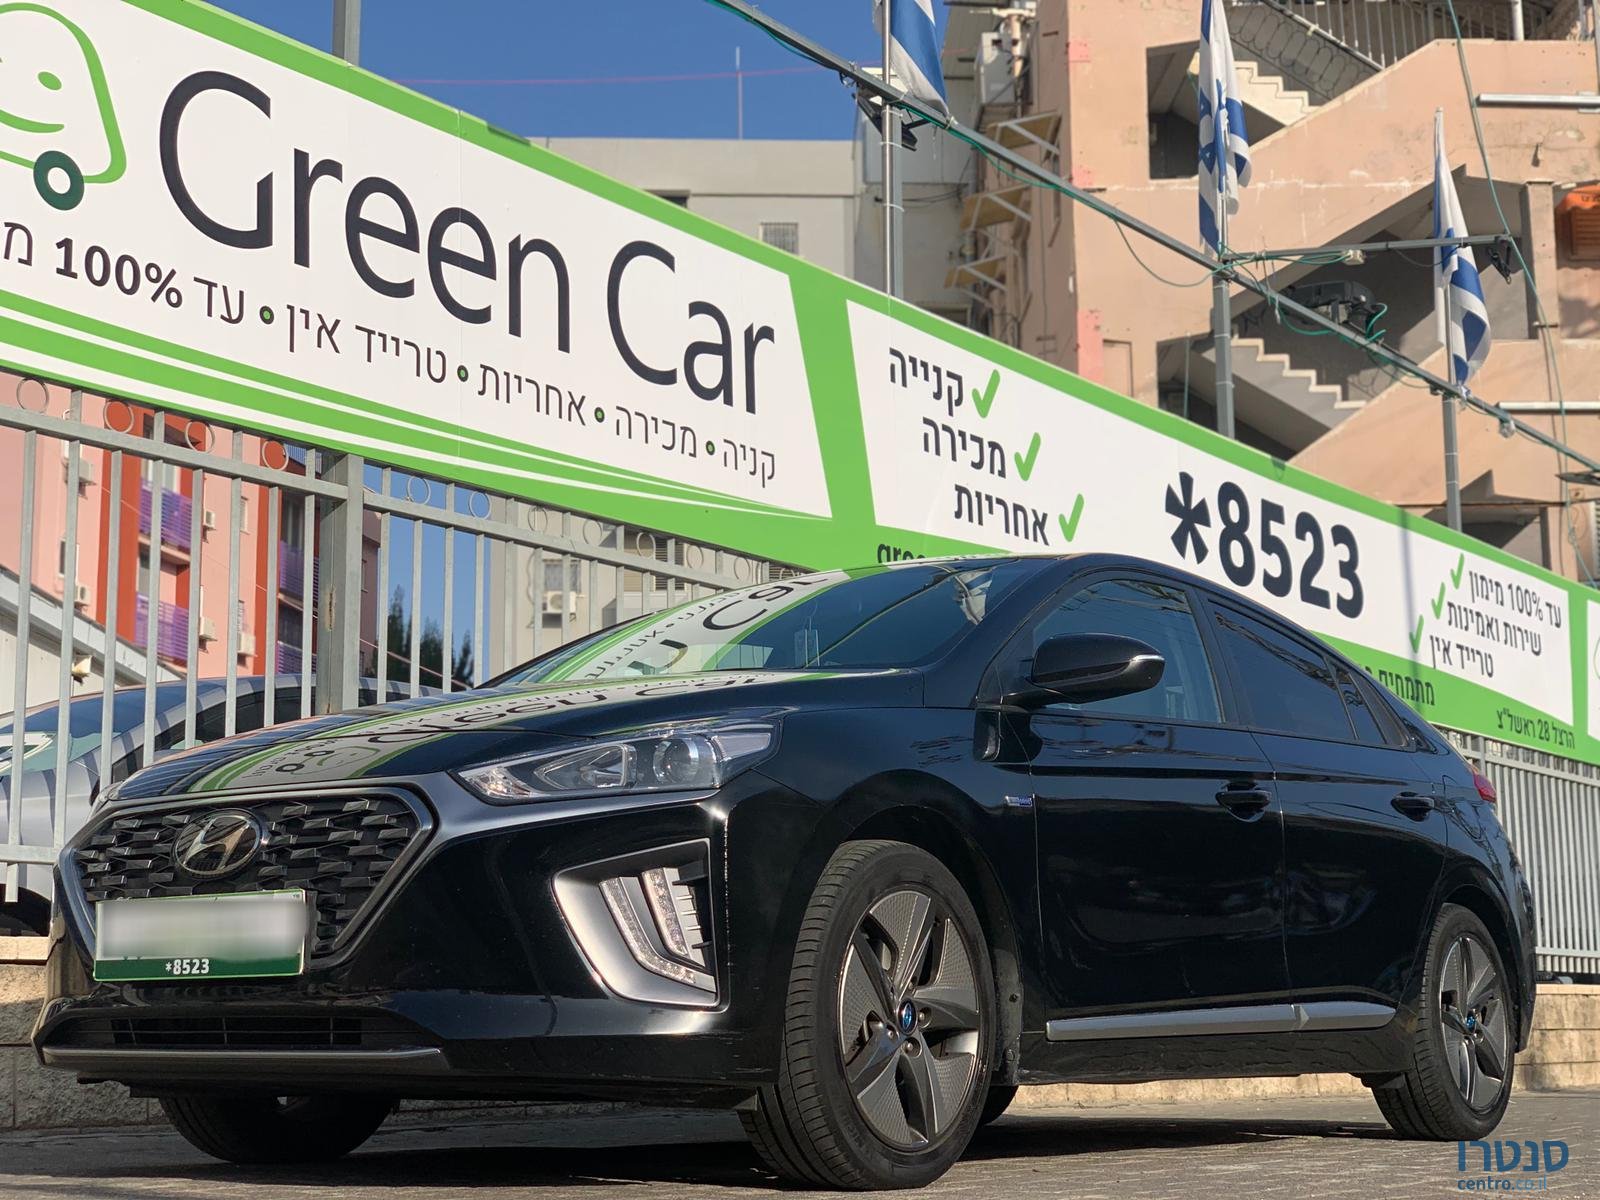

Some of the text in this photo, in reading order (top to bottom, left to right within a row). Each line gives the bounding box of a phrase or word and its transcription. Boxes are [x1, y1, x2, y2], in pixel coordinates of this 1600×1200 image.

[160, 71, 775, 415] Green Car
[55, 237, 183, 309] 100%
[193, 276, 245, 325] עד
[286, 304, 341, 354] אין
[355, 324, 447, 384] טרייד
[477, 363, 586, 426] אחריות
[889, 347, 964, 417] קנייה
[615, 405, 697, 458] מכירה
[922, 416, 1006, 479] מכירה
[723, 438, 775, 488] קניה
[954, 484, 1049, 546] אחריות
[1447, 601, 1542, 657] שירות ואמינות
[1468, 570, 1562, 629] עד 100% מימון
[1430, 634, 1494, 678] טרייד אין
[1537, 719, 1551, 742] 28
